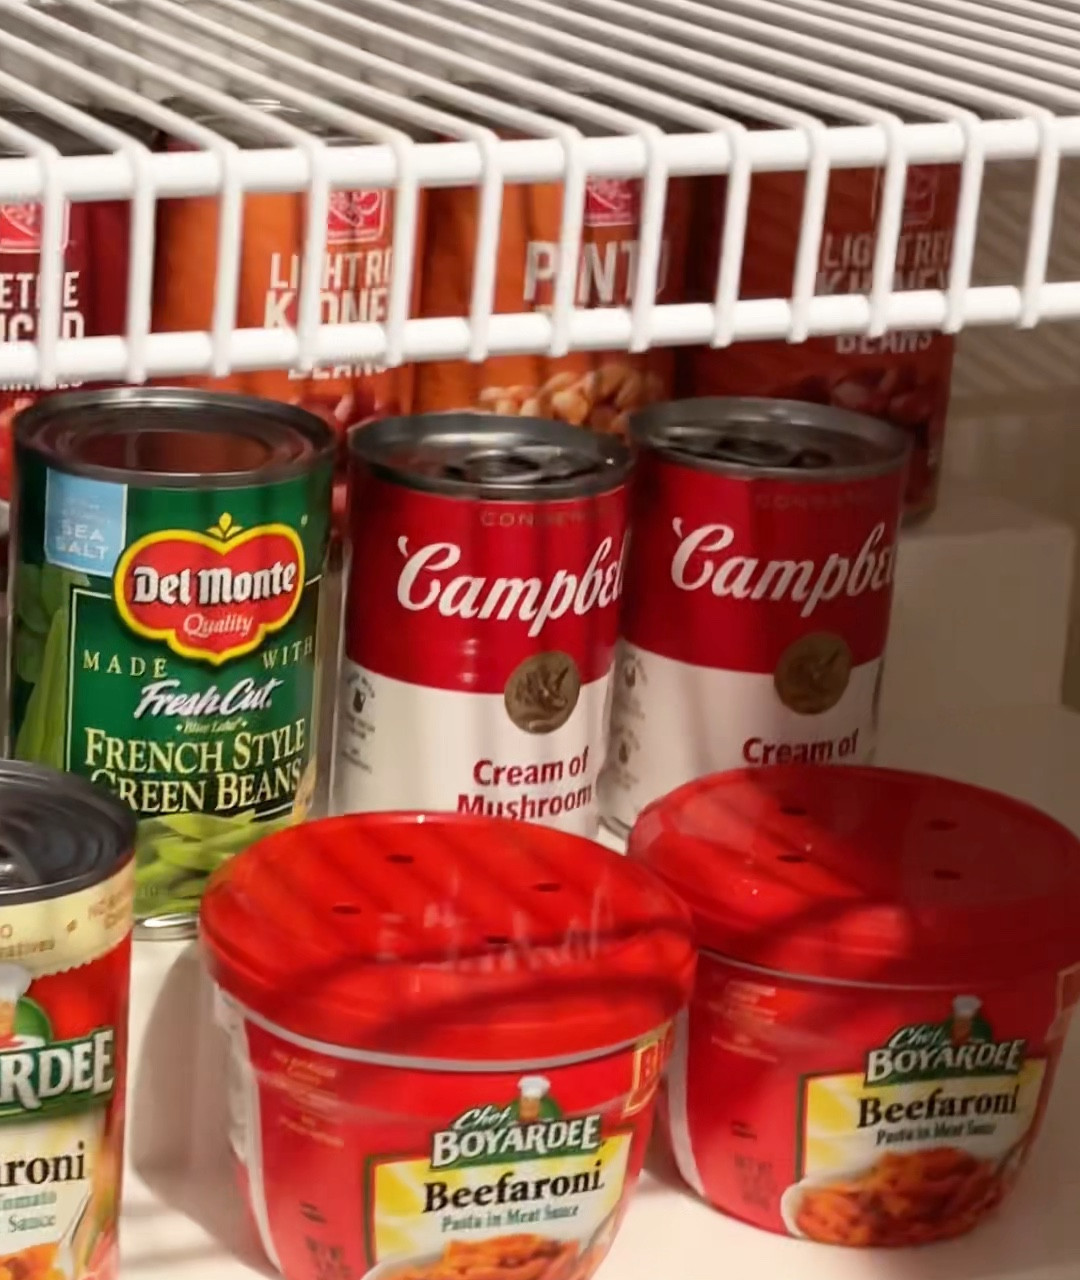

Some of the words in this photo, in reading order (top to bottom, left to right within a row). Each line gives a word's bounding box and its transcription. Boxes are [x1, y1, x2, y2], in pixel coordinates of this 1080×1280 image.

[270, 252, 364, 289] LIHT
[132, 566, 192, 606] Del
[197, 560, 297, 606] Monte
[183, 611, 254, 637] Quality
[83, 649, 169, 678] MADE
[261, 635, 313, 669] WITH
[133, 679, 221, 719] Fresh
[84, 727, 224, 774] FRENCH
[232, 718, 305, 770] STYLE
[472, 757, 564, 788] Cream
[569, 745, 590, 776] of
[742, 736, 835, 766] Cream
[838, 727, 859, 758] of
[214, 757, 302, 811] BEANS
[456, 782, 593, 821] Mushroom
[866, 1038, 1026, 1083] BOYARDEE
[857, 1084, 1020, 1129] Beefaroni
[431, 1114, 603, 1168] BOYARDEE
[422, 1160, 605, 1215] Beefaroni
[7, 1211, 57, 1235] Sauce
